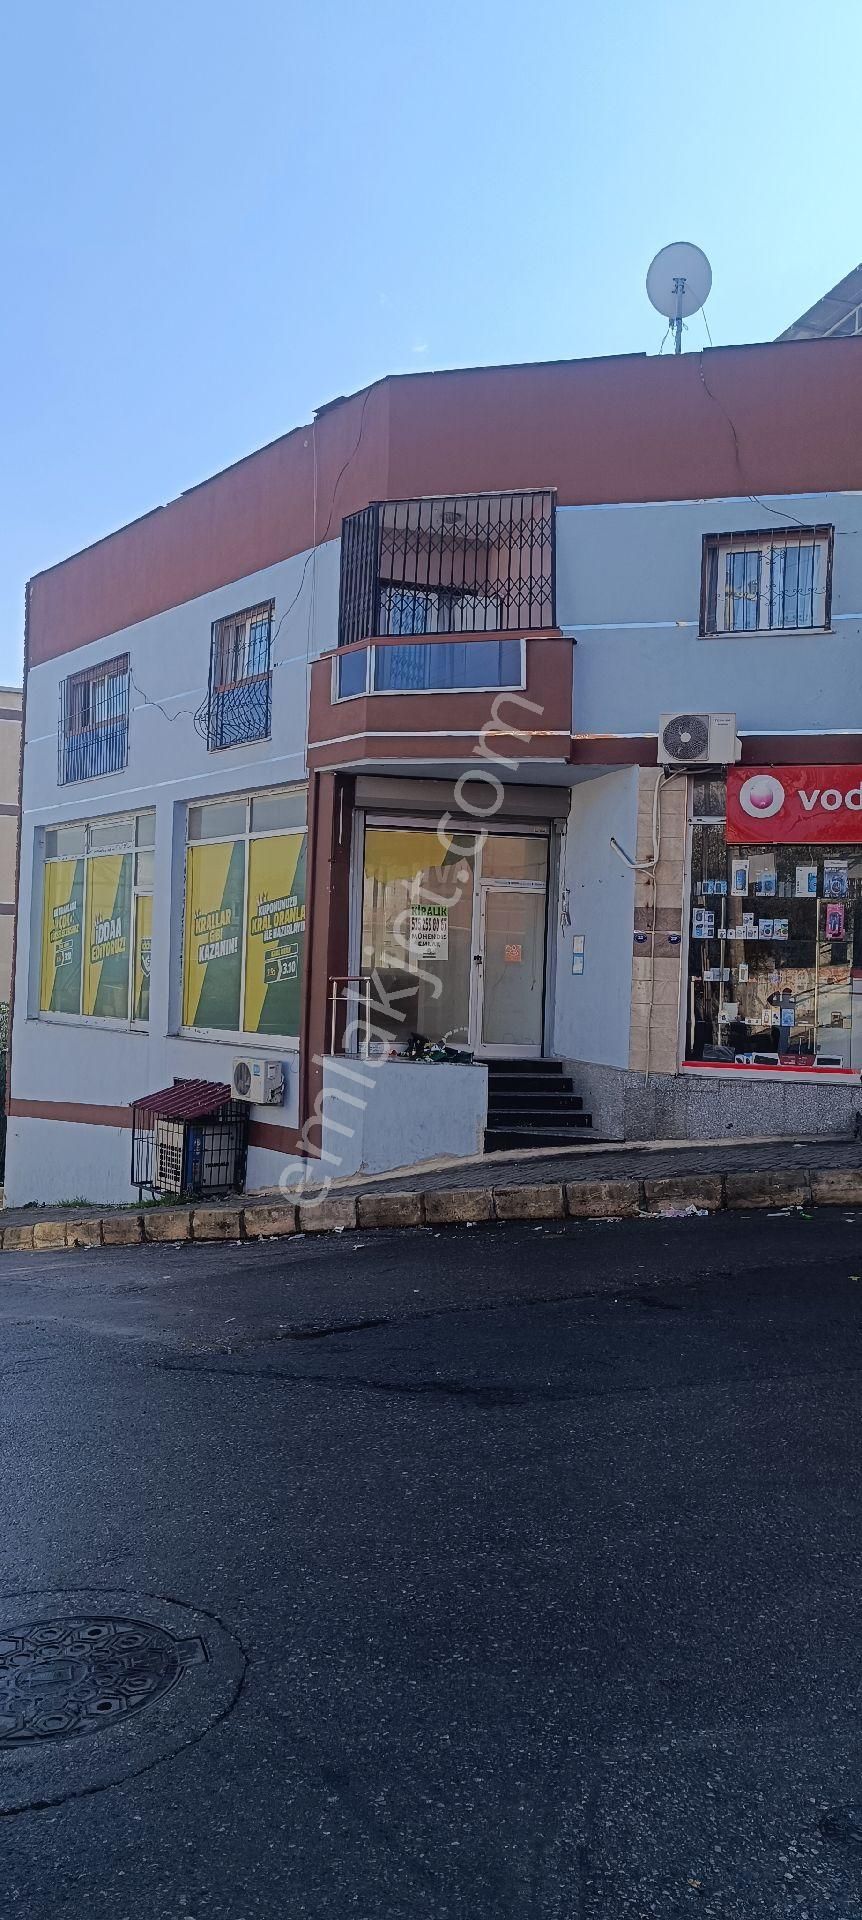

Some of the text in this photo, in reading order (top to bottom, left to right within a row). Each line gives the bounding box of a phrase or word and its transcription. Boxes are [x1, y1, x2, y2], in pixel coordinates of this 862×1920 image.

[411, 904, 448, 917] KİRALIK
[195, 909, 231, 934] KRALLAR
[251, 914, 272, 935] KRAL
[198, 936, 239, 963] KAZANIN!
[282, 960, 297, 975] 3.10
